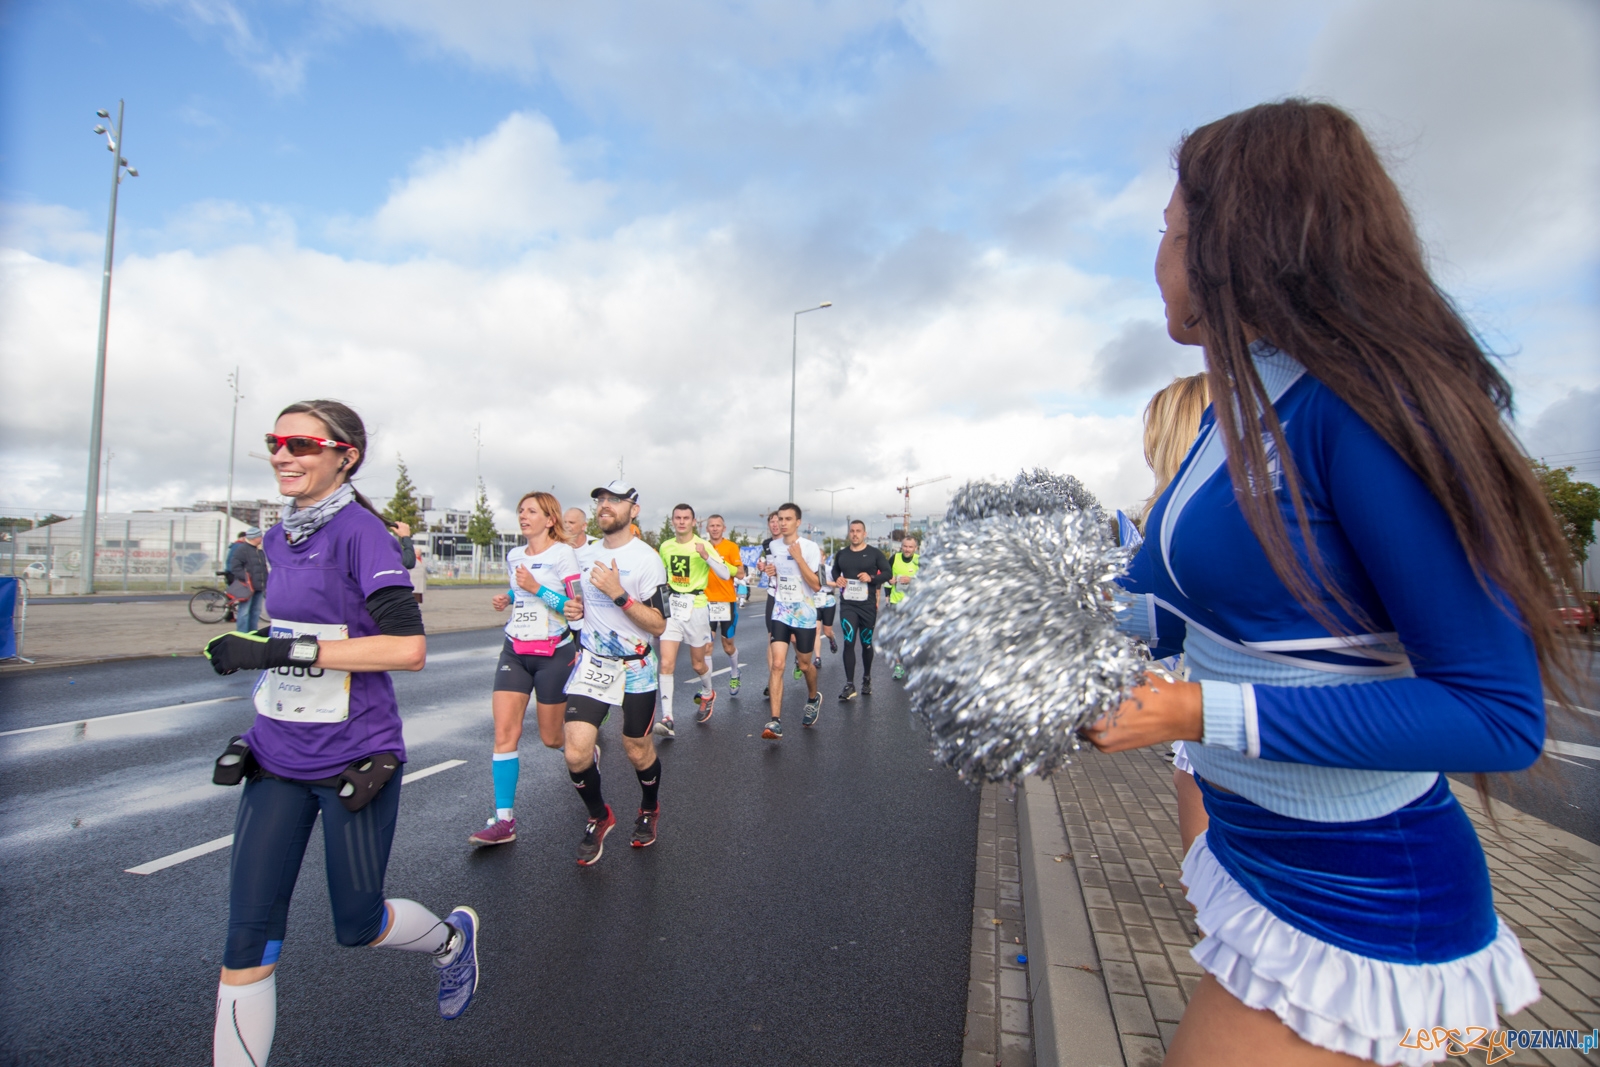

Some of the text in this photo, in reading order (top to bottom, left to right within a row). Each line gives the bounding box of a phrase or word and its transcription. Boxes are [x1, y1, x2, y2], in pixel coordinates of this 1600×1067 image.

[513, 611, 538, 622] 255
[584, 668, 615, 685] 3221
[278, 682, 302, 693] Anna
